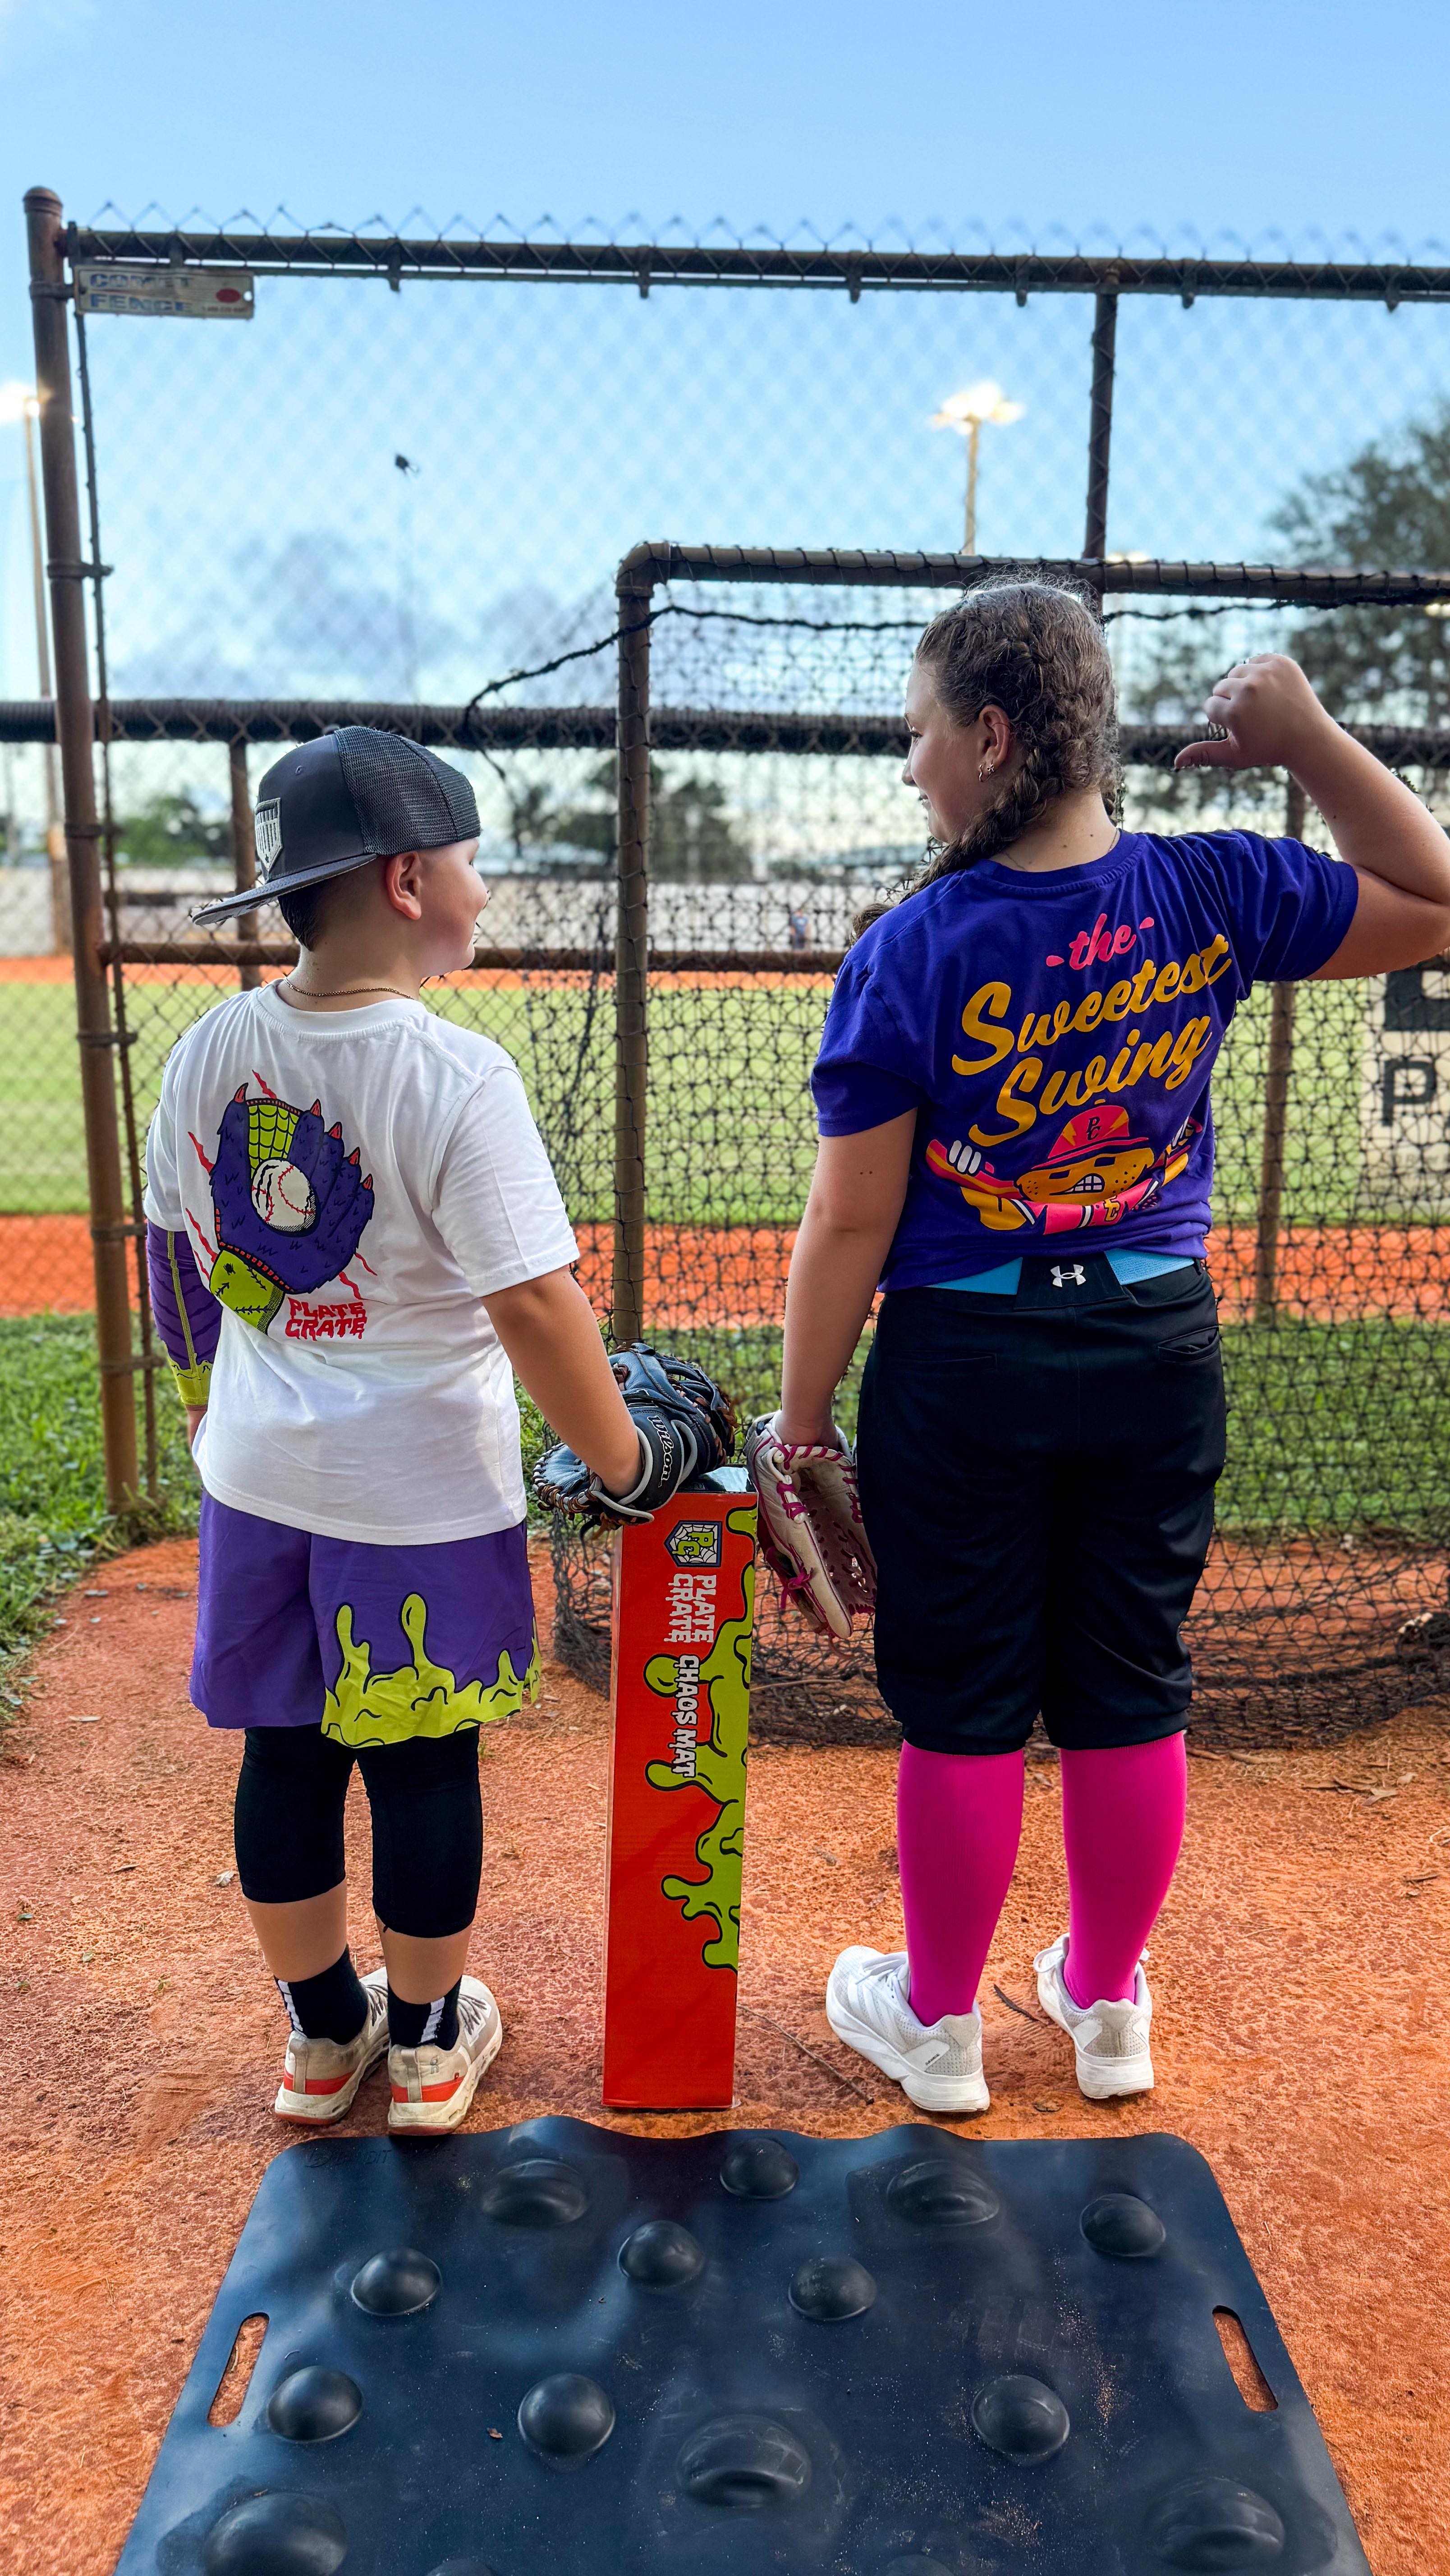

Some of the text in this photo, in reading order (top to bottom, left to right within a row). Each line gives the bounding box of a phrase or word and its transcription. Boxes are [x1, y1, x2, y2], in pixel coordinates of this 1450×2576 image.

[91, 294, 193, 311] FENCE
[952, 934, 1231, 1075] Sweetest
[968, 1016, 1212, 1146] Swing
[285, 1316, 367, 1341] CRATE
[288, 1297, 366, 1320] PLATE
[672, 1532, 714, 1556] PC
[664, 1573, 693, 1642] CRATE
[691, 1574, 716, 1642] PLATE
[668, 1655, 699, 1777] CHAOS MAT
